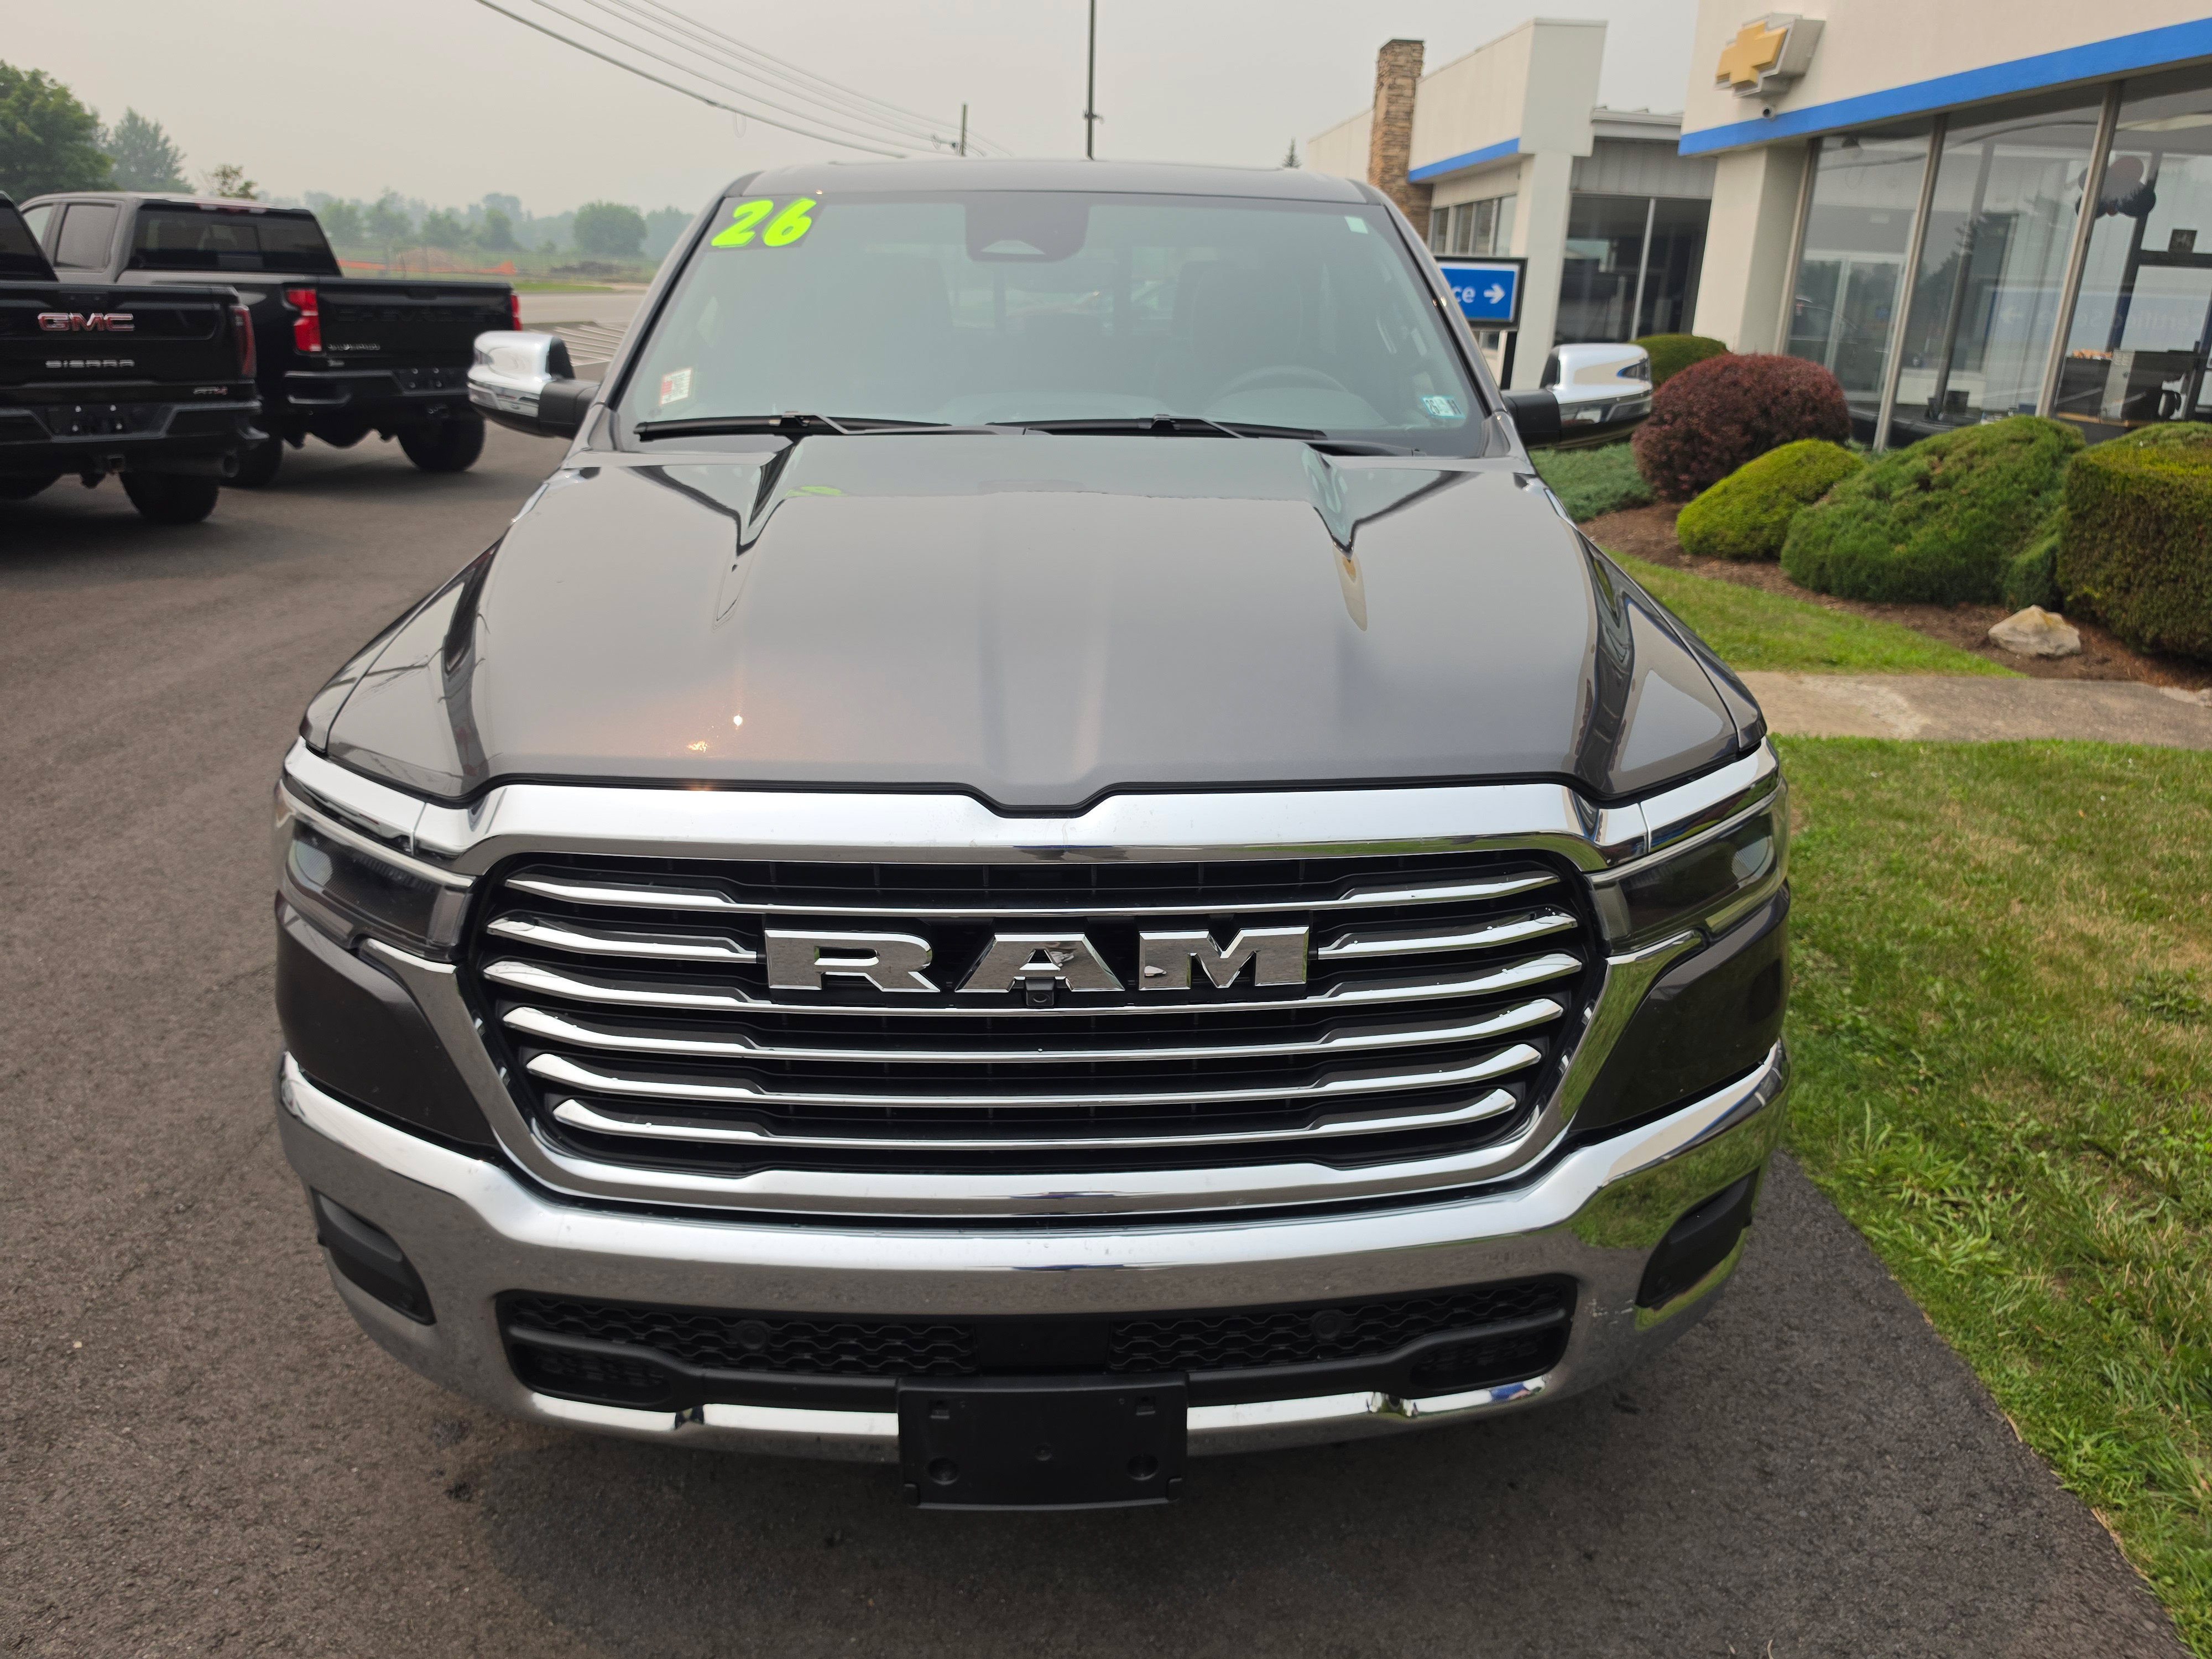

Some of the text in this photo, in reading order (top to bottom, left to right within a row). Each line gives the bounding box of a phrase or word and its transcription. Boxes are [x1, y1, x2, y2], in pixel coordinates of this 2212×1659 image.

[710, 197, 817, 248] 26
[38, 312, 135, 331] GMC
[764, 926, 1311, 993] RAM
